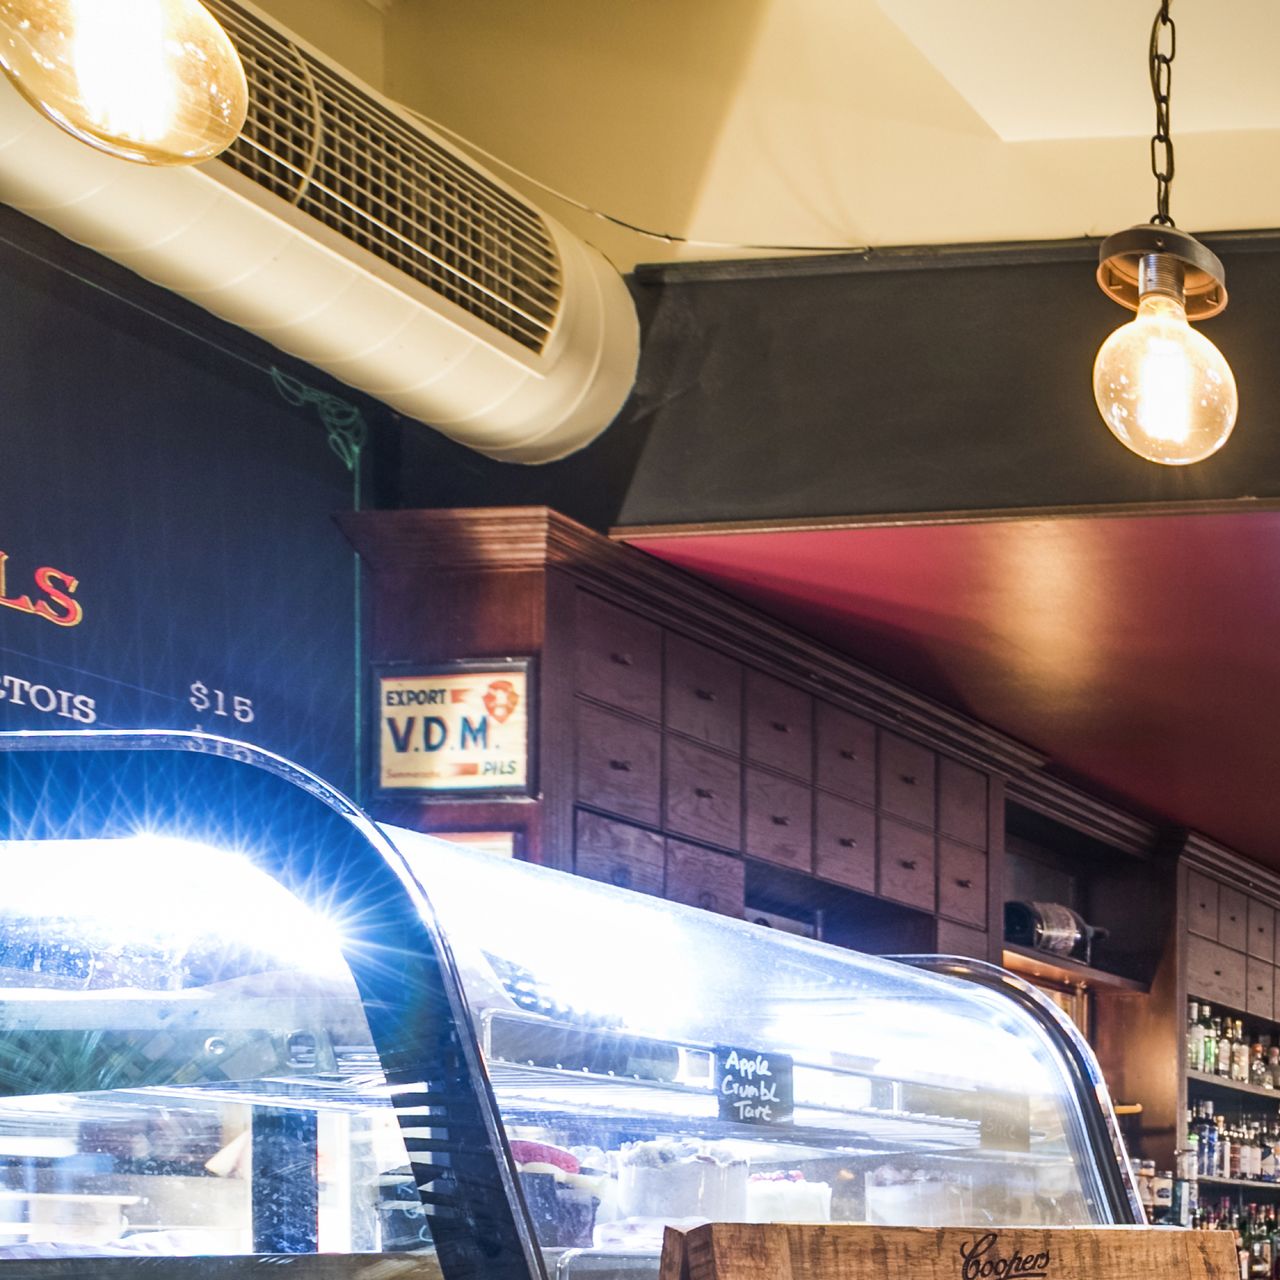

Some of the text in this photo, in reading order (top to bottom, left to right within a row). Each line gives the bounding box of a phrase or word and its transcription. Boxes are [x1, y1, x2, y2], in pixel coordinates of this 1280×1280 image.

[0, 674, 255, 724] TOIS $15
[386, 688, 447, 706] EXPORT
[482, 760, 518, 776] PILS
[725, 1050, 772, 1080] Apple
[733, 1100, 772, 1121] Tart
